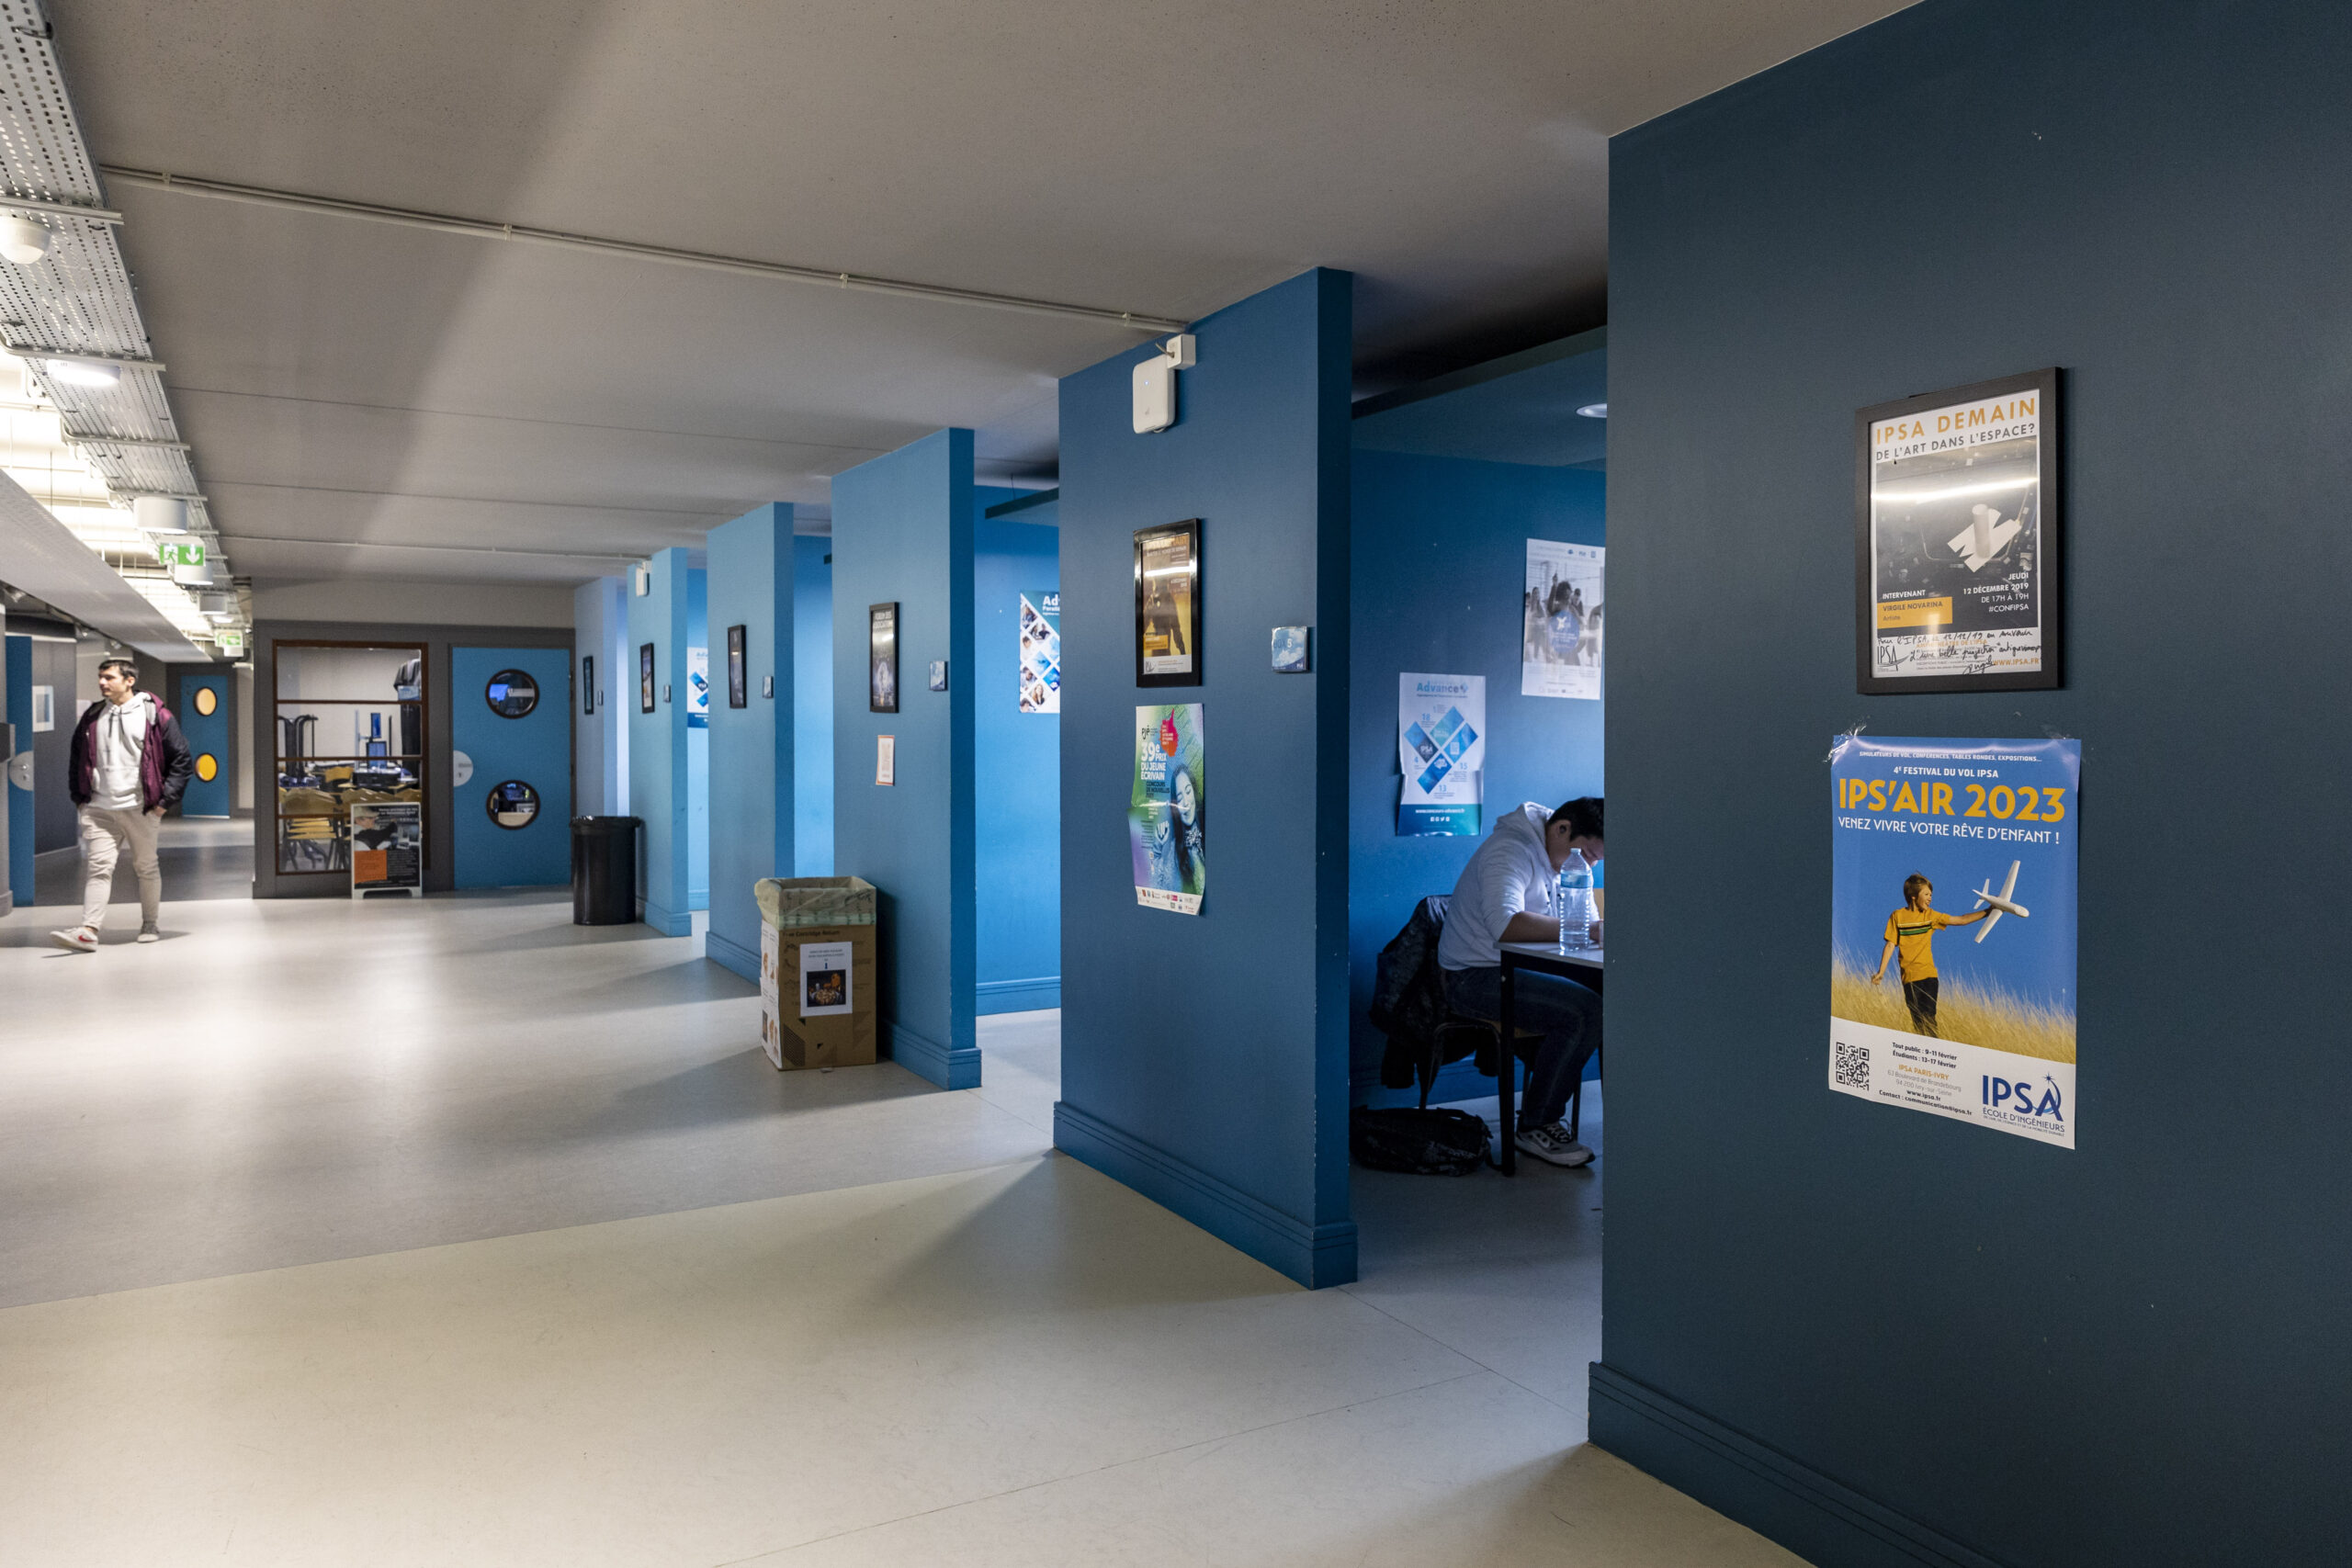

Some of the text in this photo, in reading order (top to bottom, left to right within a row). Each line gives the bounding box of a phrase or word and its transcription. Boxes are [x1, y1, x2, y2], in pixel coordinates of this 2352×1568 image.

[1876, 398, 2035, 446] IPSA DEMAIN
[1876, 423, 2036, 461] DE L'ART DANS L'ESPACE?
[2007, 571, 2030, 581] JEUDI
[1973, 583, 2009, 594] DÉCEMBRE
[2010, 582, 2030, 591] 2019
[1883, 590, 1926, 600] INTERVENANT
[1883, 601, 1943, 612] VIRGILE NOVARINA
[1988, 603, 2030, 613] #CONFIPSA
[1417, 680, 1459, 694] Advance
[1421, 713, 1431, 721] 18
[1155, 752, 1167, 761] PRIX
[1140, 761, 1167, 772] DU JEUNE
[1903, 766, 1942, 776] FESTIVAL
[1943, 768, 1956, 776] DU
[1958, 769, 1975, 777] VOL
[1976, 770, 1999, 778] IPSA
[1838, 777, 2066, 823] IPS'AIR 2023
[1838, 816, 1871, 830] VENEZ
[1872, 818, 1907, 833] VIVRE
[1909, 821, 1950, 836] VOTRE
[1952, 823, 1984, 839] RÊVE
[1987, 827, 2052, 844] D'ENFANT
[1904, 1045, 1921, 1054] public
[1938, 1052, 1958, 1061] février
[1893, 1050, 1918, 1061] Étudiants
[1921, 1056, 1937, 1066] 13-17
[1937, 1059, 1957, 1069] février
[1898, 1064, 1913, 1073] IPSA
[1879, 1089, 1901, 1100] Contact
[1906, 1089, 1941, 1101] www.ipsa.fr
[1982, 1075, 2064, 1122] IPSA
[1983, 1107, 2065, 1133] ÉCOLE D'INGÉNIEURS
